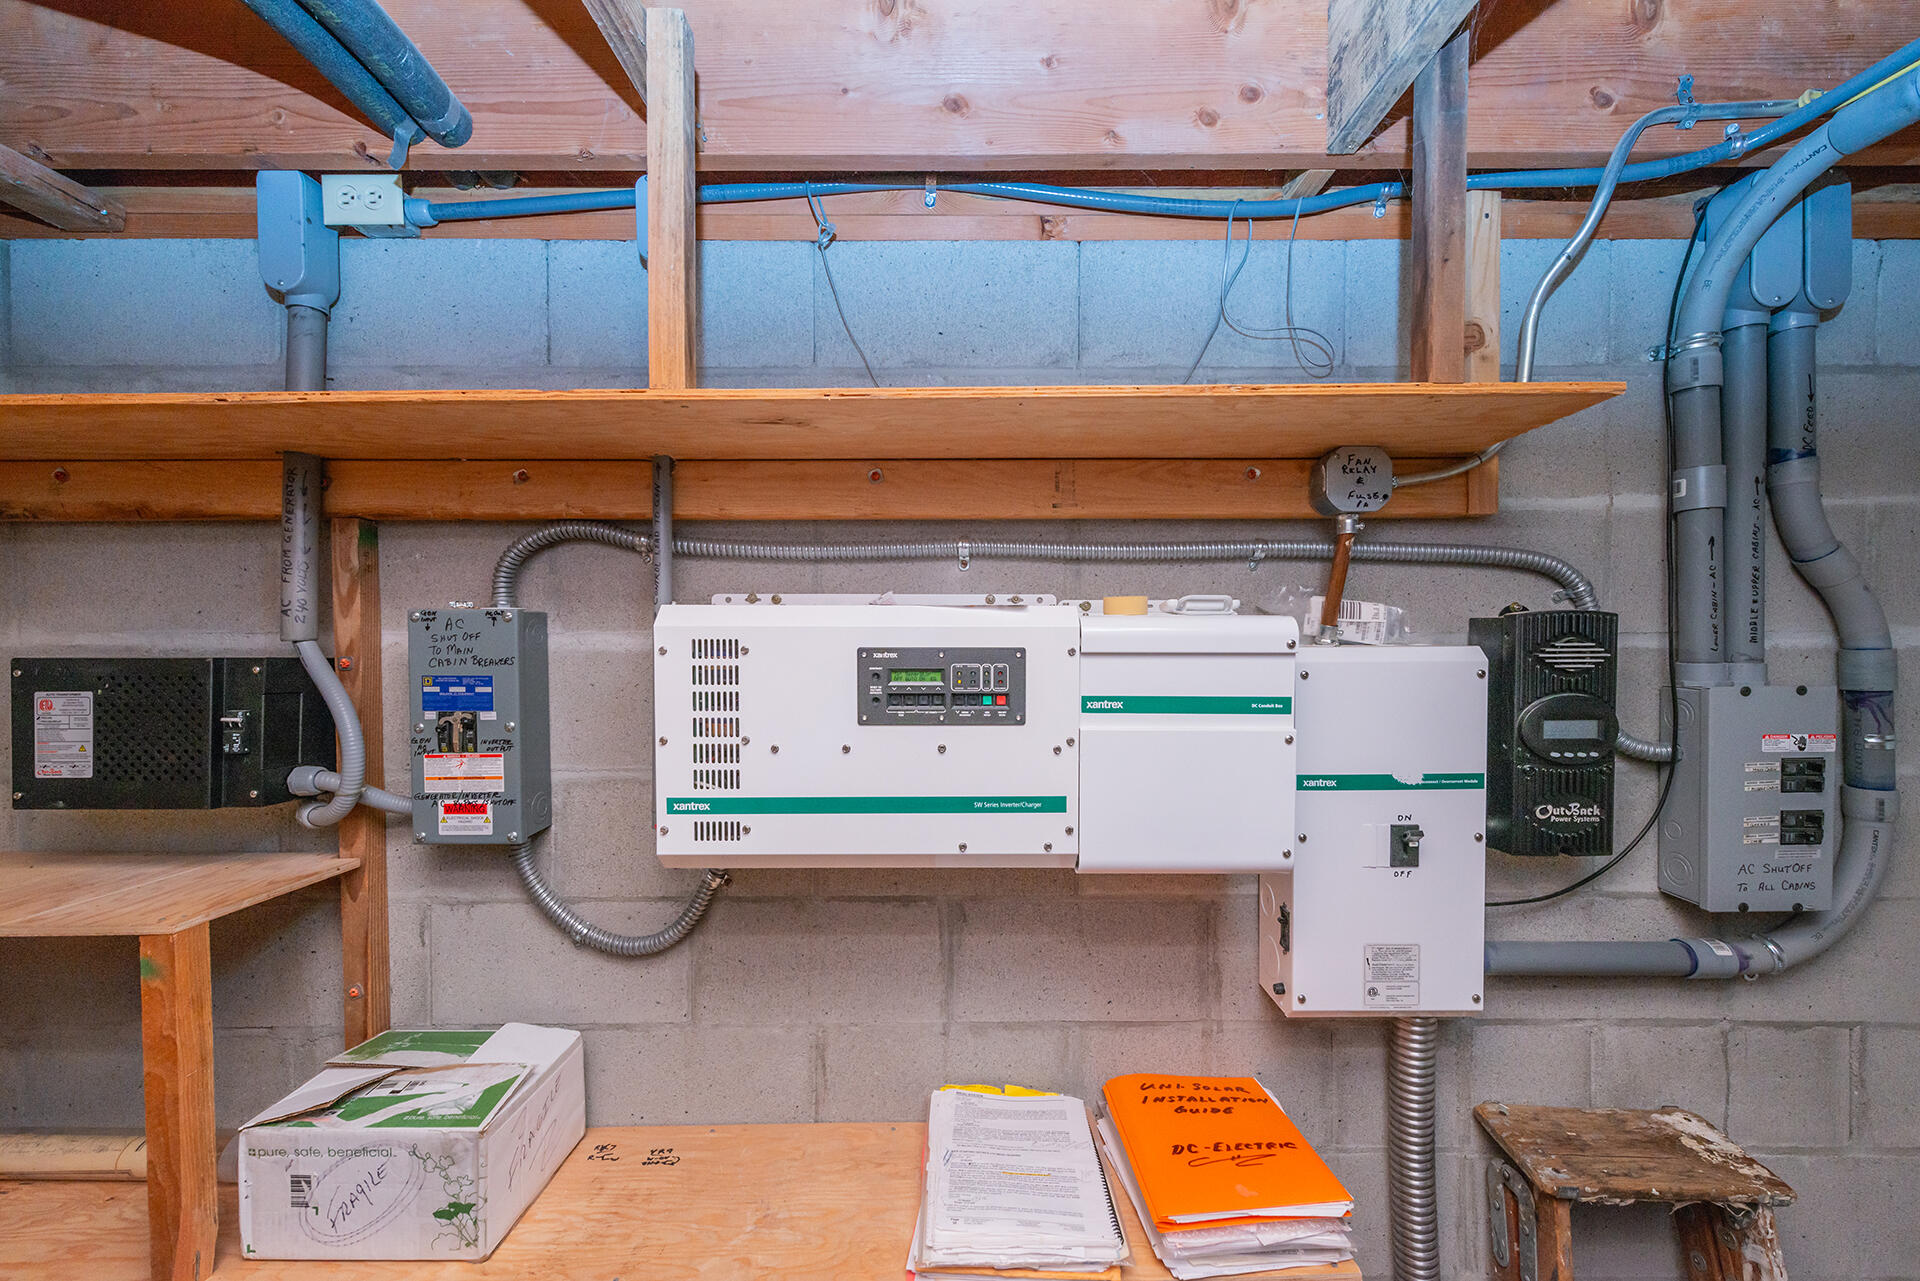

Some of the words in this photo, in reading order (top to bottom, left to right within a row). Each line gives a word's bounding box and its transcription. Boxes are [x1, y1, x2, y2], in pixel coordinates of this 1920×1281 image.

[1347, 453, 1371, 466] FAN
[1341, 464, 1377, 475] RELAY
[282, 467, 297, 543] GENERATOR
[1752, 523, 1760, 560] CABINS
[281, 549, 293, 583] FROM
[1709, 564, 1717, 579] AC
[1751, 565, 1760, 597] UPPER
[281, 599, 292, 617] AC
[294, 598, 310, 624] 240
[1710, 590, 1718, 620] CABIN
[445, 617, 465, 631] AC
[1749, 607, 1758, 644] MIDDLE
[430, 634, 458, 643] SHUT
[462, 632, 480, 641] OFF
[428, 645, 441, 655] TO
[446, 643, 474, 655] MAIN
[428, 657, 467, 668] CABIN
[471, 655, 515, 668] BREAKERS
[1086, 700, 1123, 709] xantrex
[1303, 778, 1337, 787] xantrex
[445, 803, 486, 814] WARNING
[673, 802, 710, 811] xantrex
[1000, 801, 1042, 809] Inverter/Charger
[1535, 802, 1600, 819] OutBack
[1397, 814, 1412, 822] ON
[1394, 870, 1412, 878] OFF
[1737, 863, 1755, 875] AC
[1758, 882, 1775, 891] ALL
[1781, 880, 1816, 891] CABINS
[1192, 1082, 1251, 1094] SOLAR
[1142, 1095, 1268, 1104] INSTALLATION
[1174, 1105, 1235, 1114] GUIDE
[257, 1148, 289, 1161] pure,
[294, 1148, 323, 1158] safe,
[327, 1162, 389, 1233] FRAGILE
